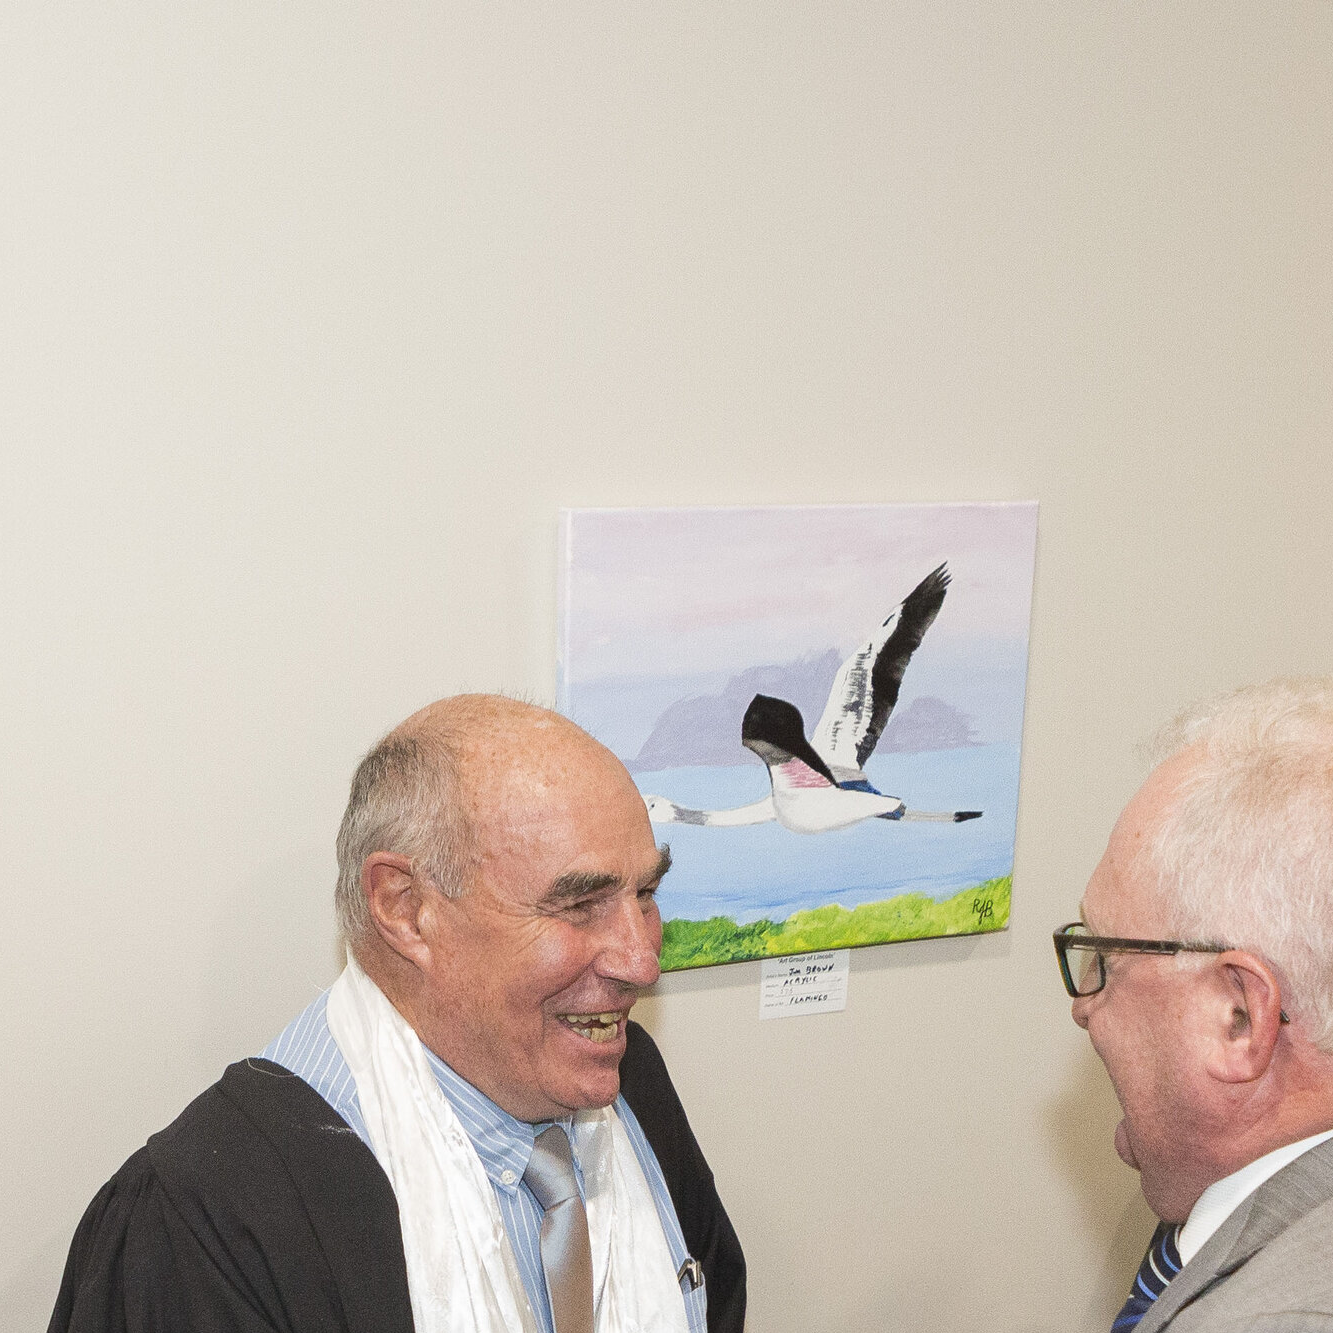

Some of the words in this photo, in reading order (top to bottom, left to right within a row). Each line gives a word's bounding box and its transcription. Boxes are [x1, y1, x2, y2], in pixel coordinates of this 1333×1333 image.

[788, 955, 806, 964] Group
[783, 975, 818, 987] ACRYLIC
[789, 994, 828, 1005] FLAMINGO
